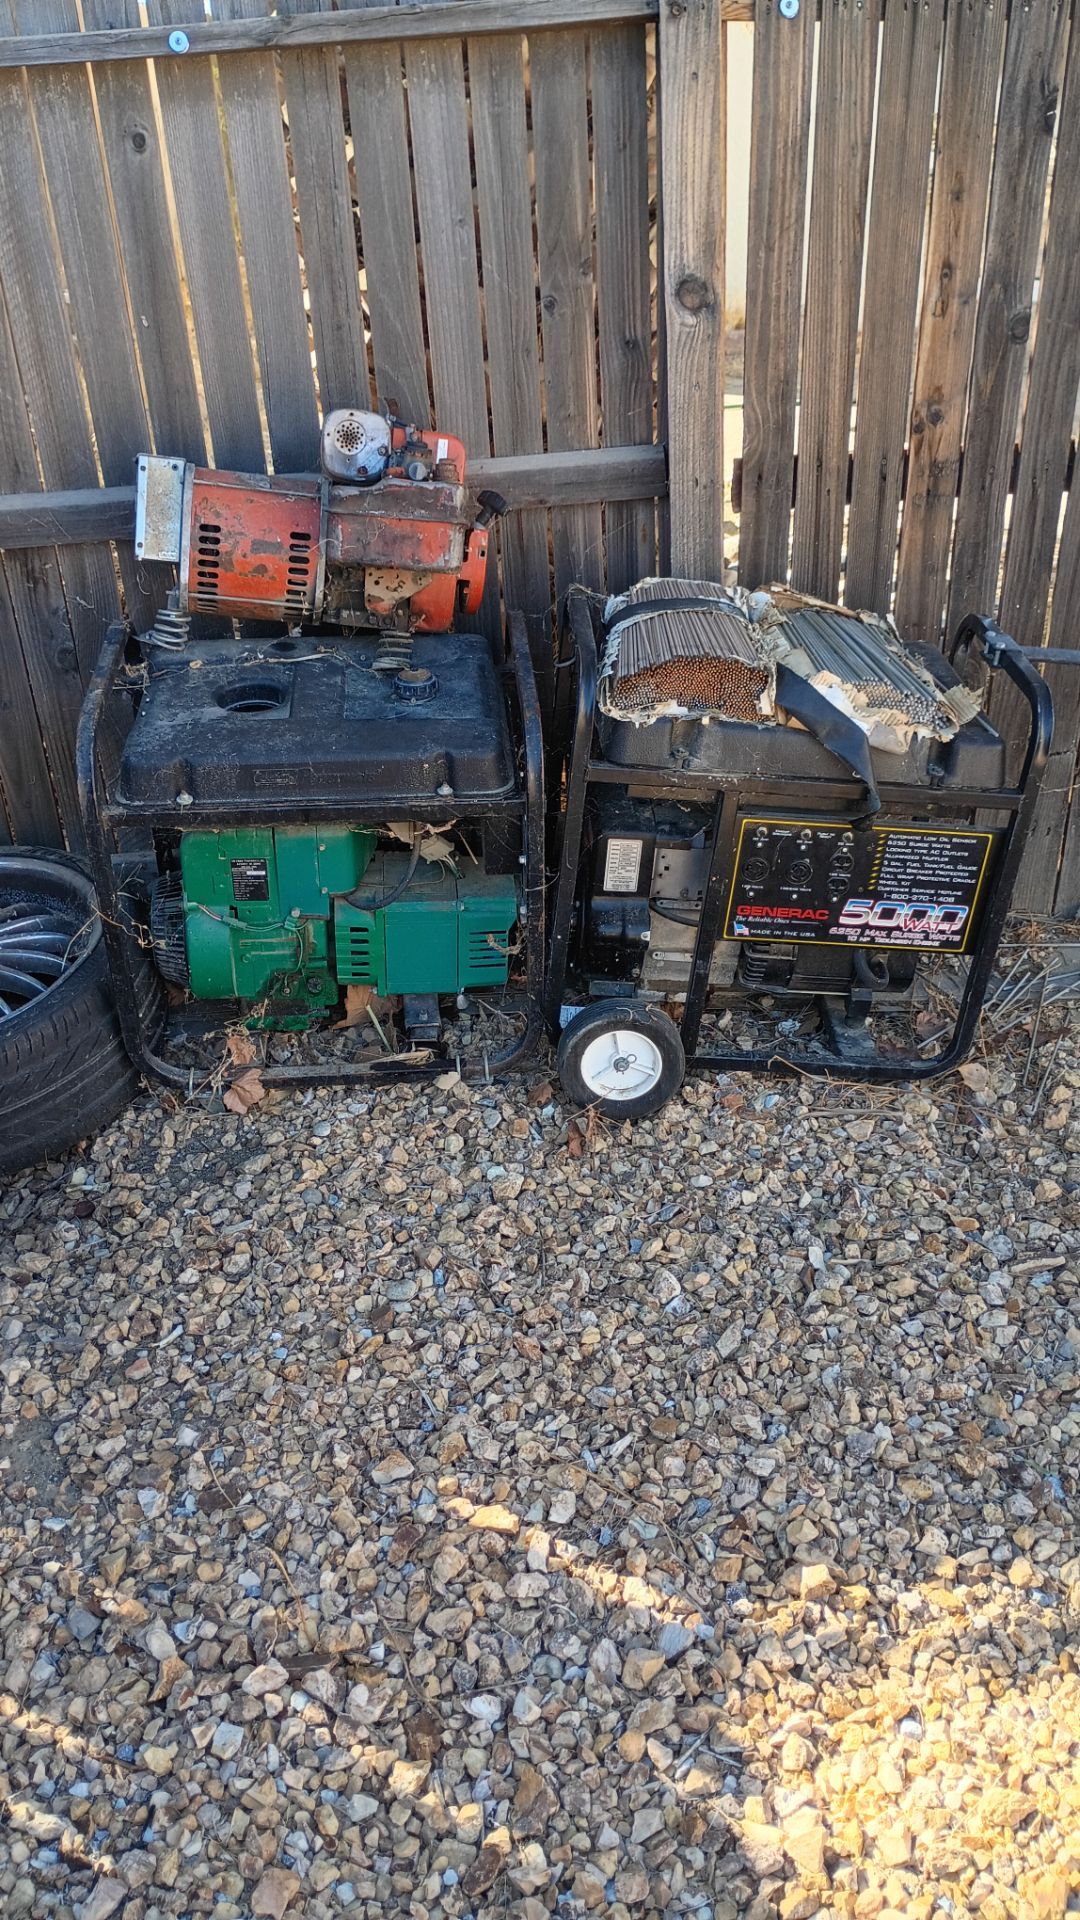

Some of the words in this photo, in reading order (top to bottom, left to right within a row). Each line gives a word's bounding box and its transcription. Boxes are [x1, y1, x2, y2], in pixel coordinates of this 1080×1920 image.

[736, 905, 830, 920] GENERAC
[838, 898, 969, 931] 5000
[902, 916, 958, 934] WATT
[864, 929, 888, 937] MAX
[891, 931, 925, 939] SURGE
[929, 934, 961, 942] WATTS
